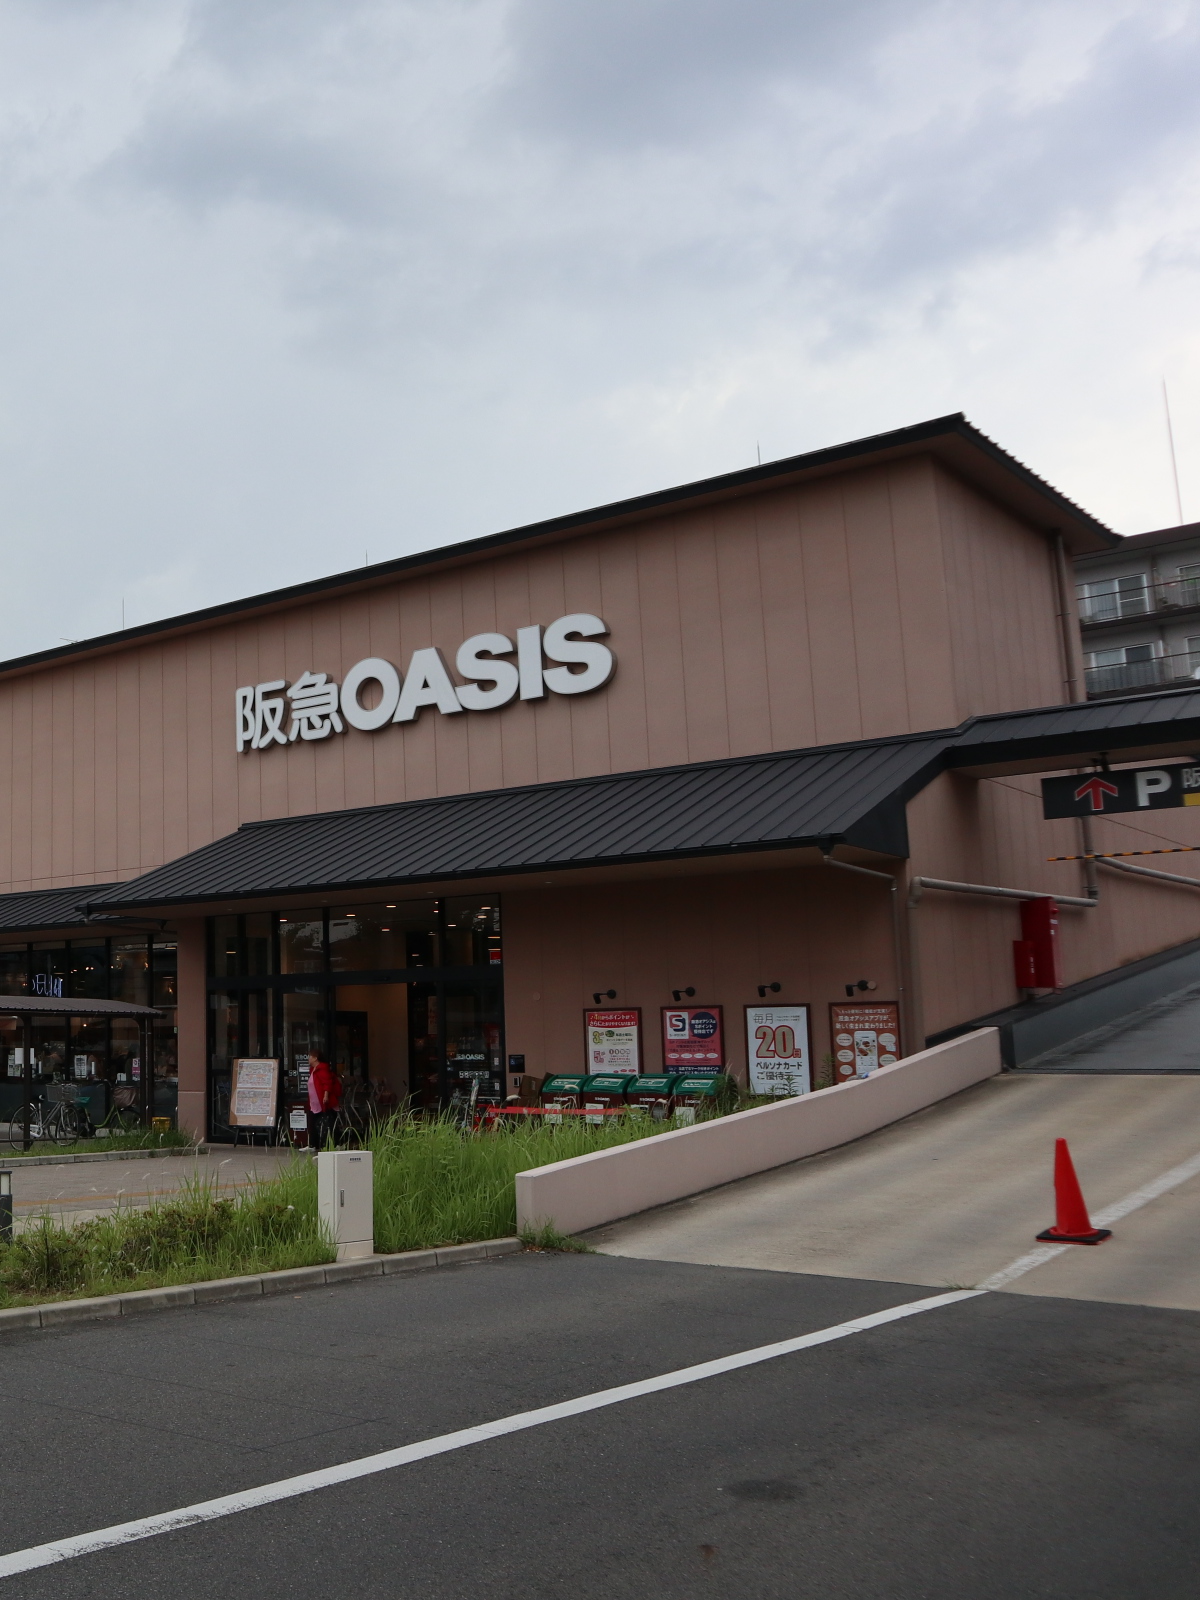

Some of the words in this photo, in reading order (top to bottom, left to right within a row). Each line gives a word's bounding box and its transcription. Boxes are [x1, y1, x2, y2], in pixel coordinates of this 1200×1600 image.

[236, 613, 617, 754] 阪急OASIS
[1135, 769, 1172, 807] P
[753, 1013, 774, 1024] 毎月
